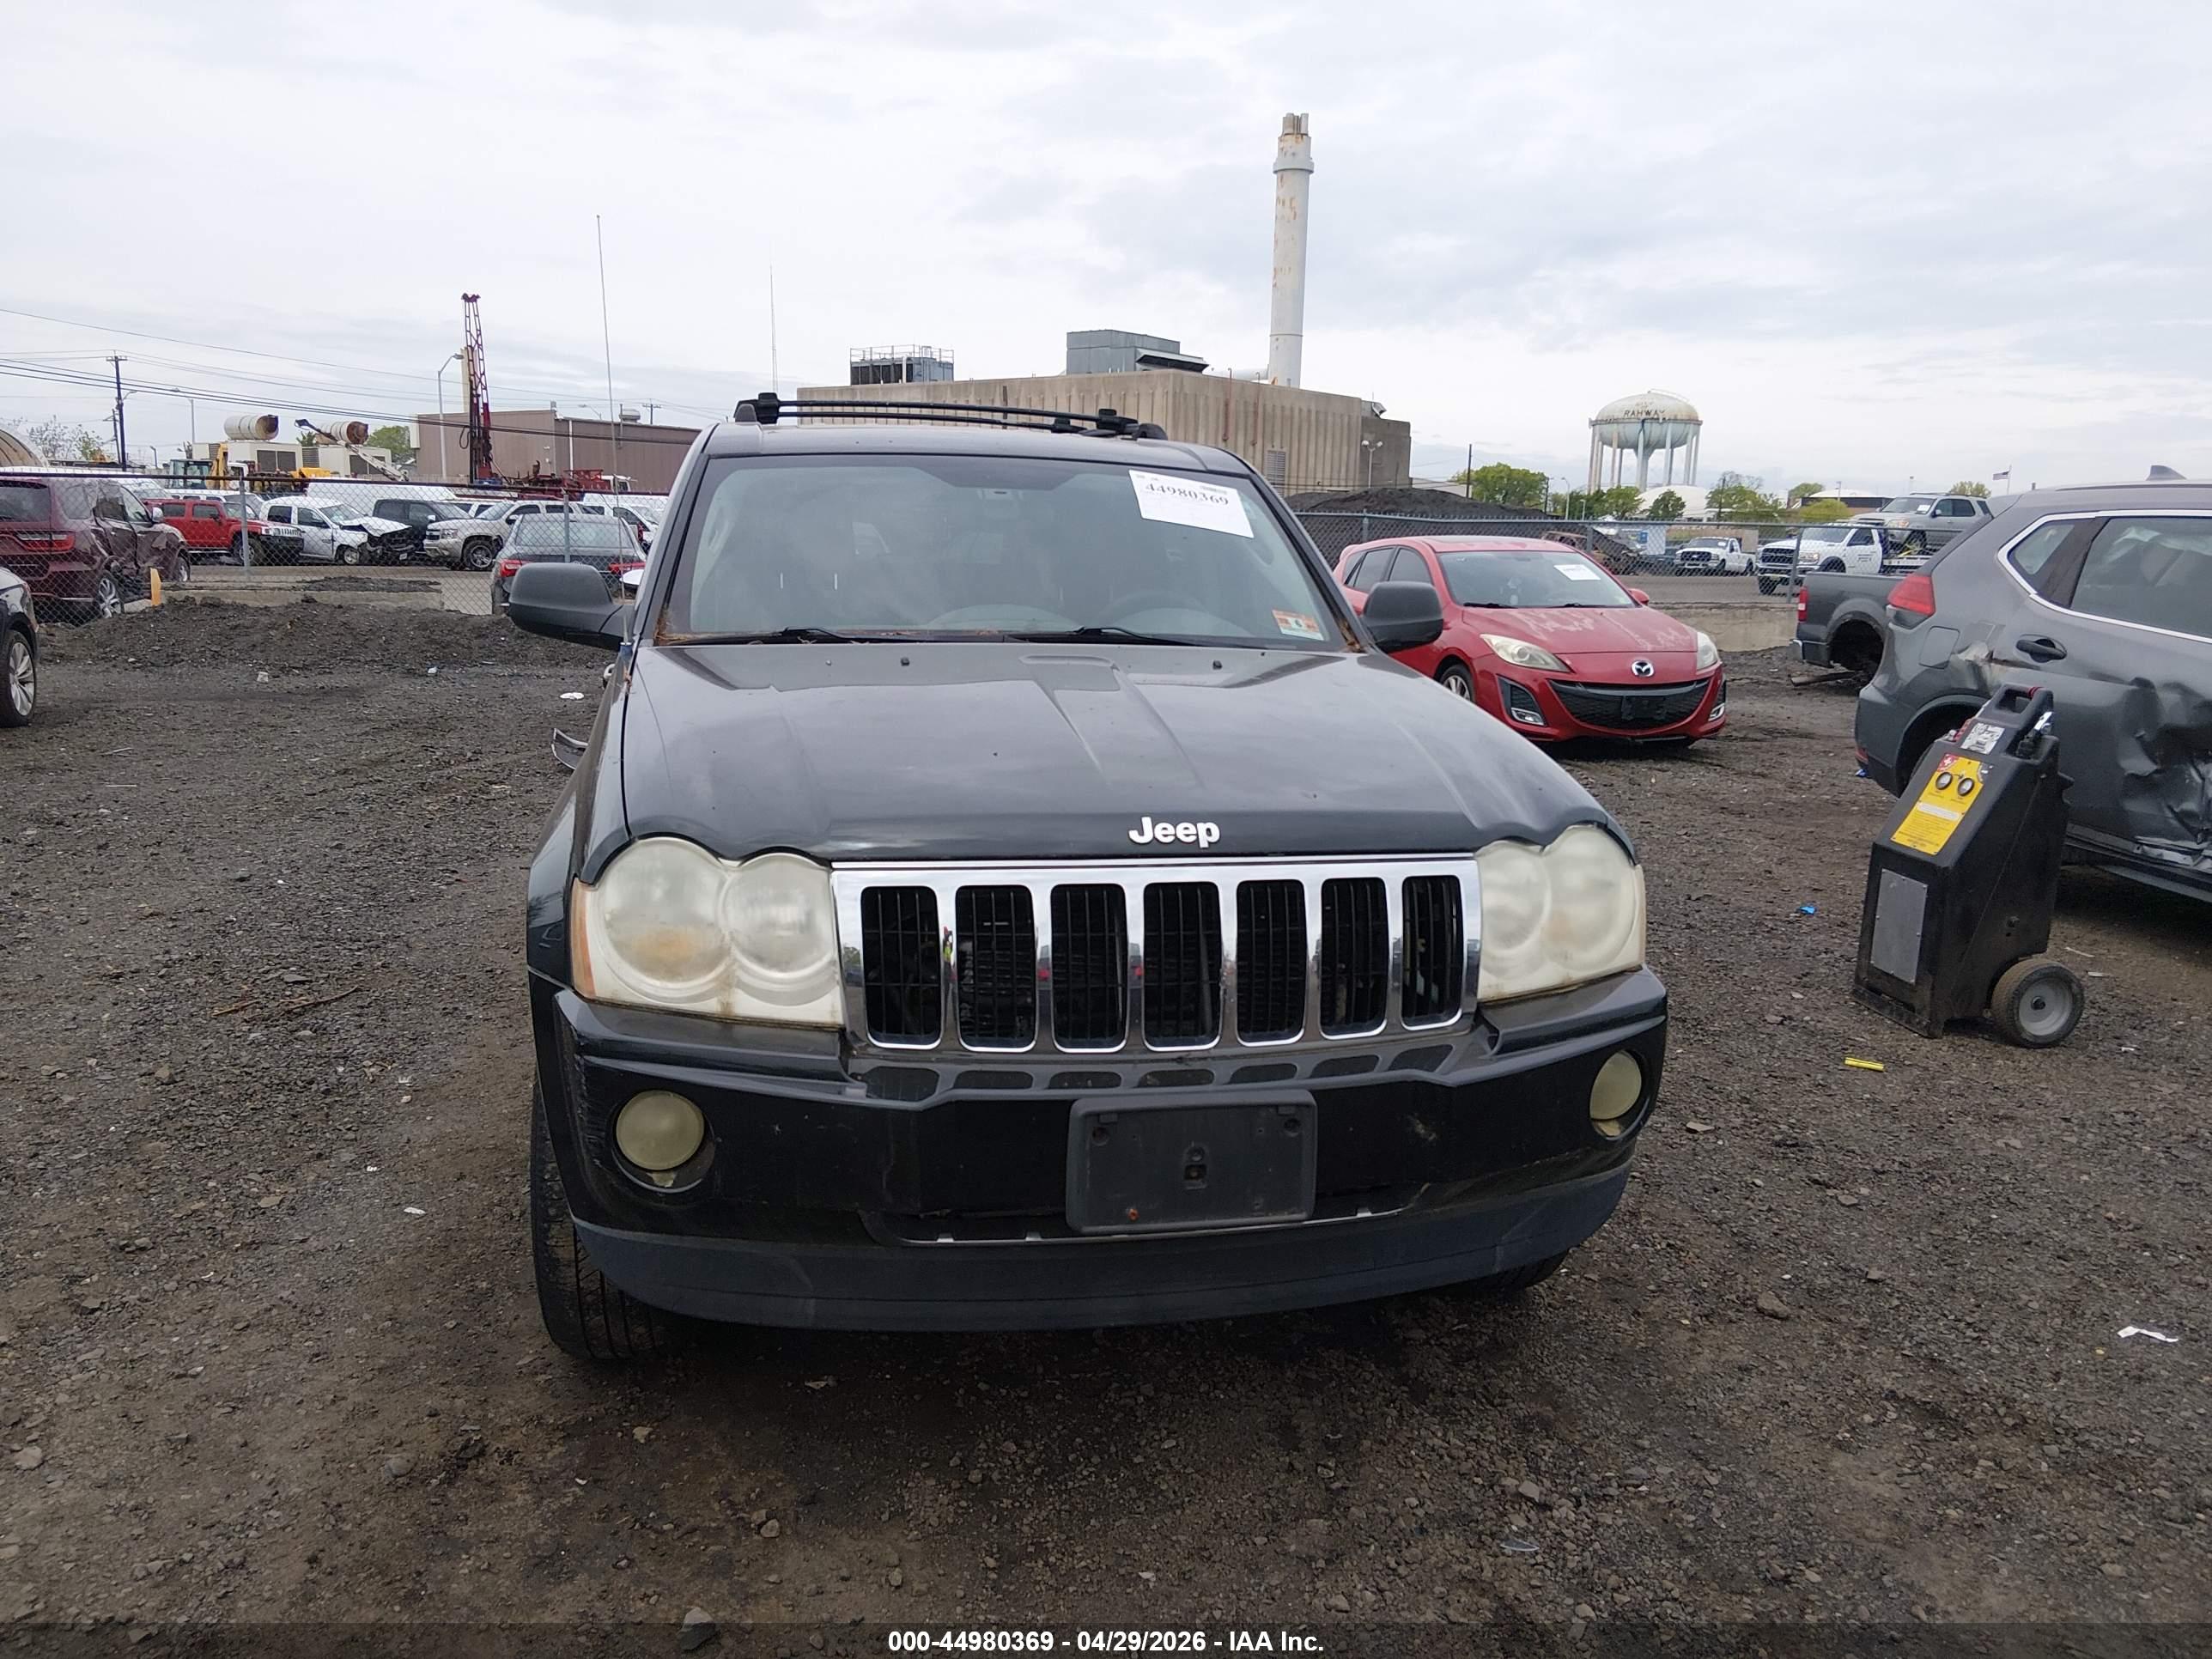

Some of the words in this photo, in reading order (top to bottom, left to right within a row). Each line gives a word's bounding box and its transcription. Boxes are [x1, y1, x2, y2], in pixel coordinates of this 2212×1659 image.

[1623, 409, 1666, 417] RAHWAY
[1145, 483, 1230, 507] 44980369
[1128, 816, 1220, 848] Jeep
